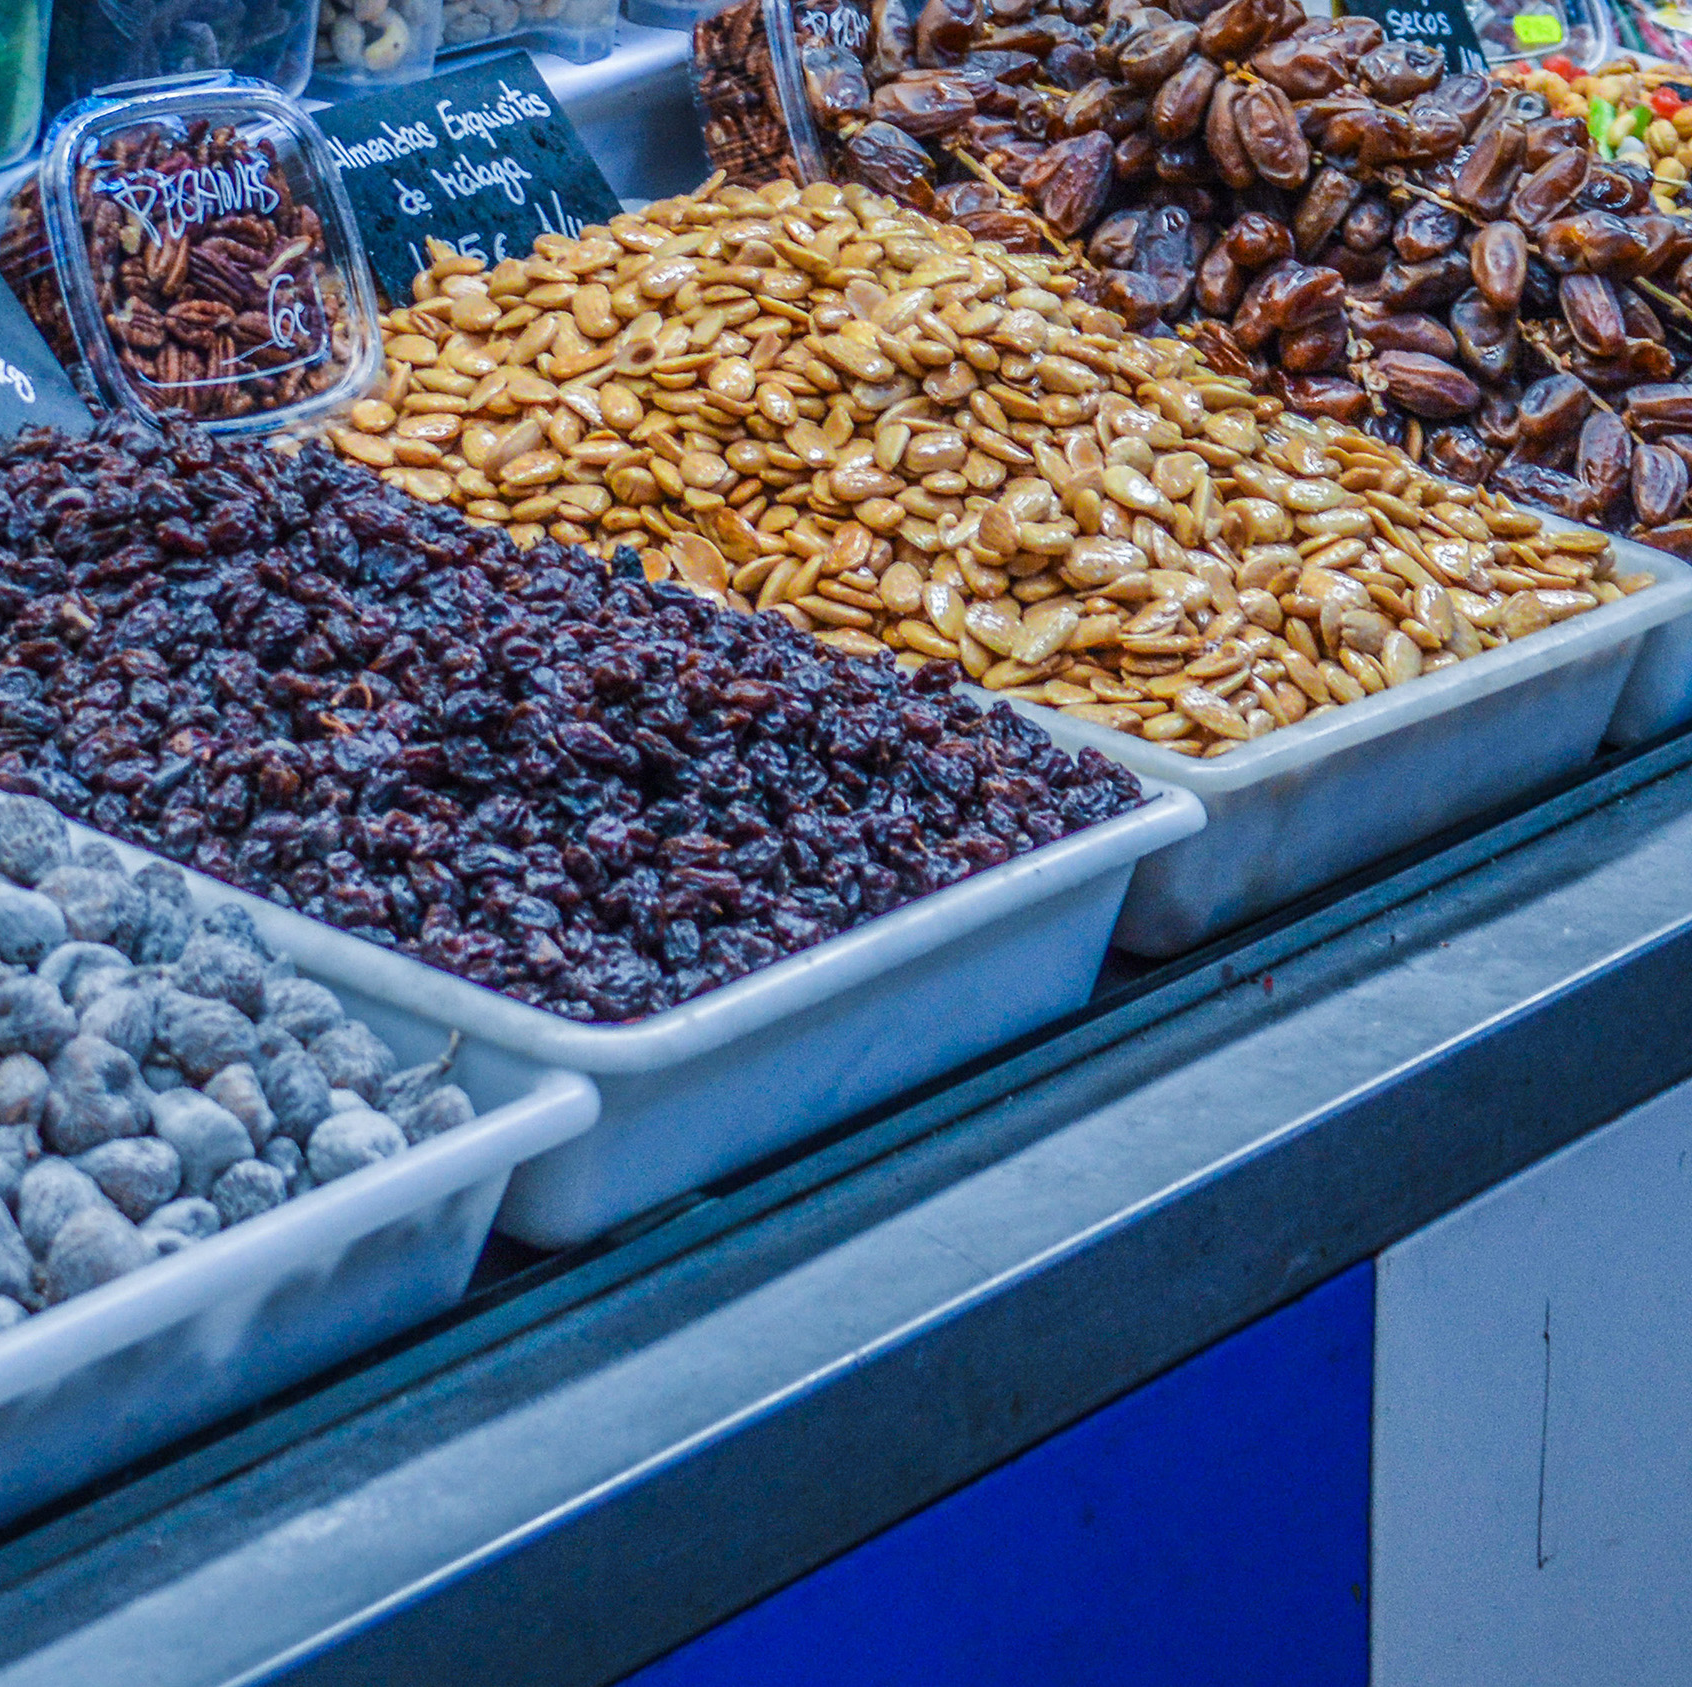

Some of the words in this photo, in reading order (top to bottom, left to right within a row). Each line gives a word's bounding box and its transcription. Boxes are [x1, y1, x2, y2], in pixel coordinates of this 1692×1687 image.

[1386, 8, 1453, 36] secos
[436, 79, 552, 150] Exquisitas
[393, 178, 432, 216] de
[431, 153, 532, 206] Málaga
